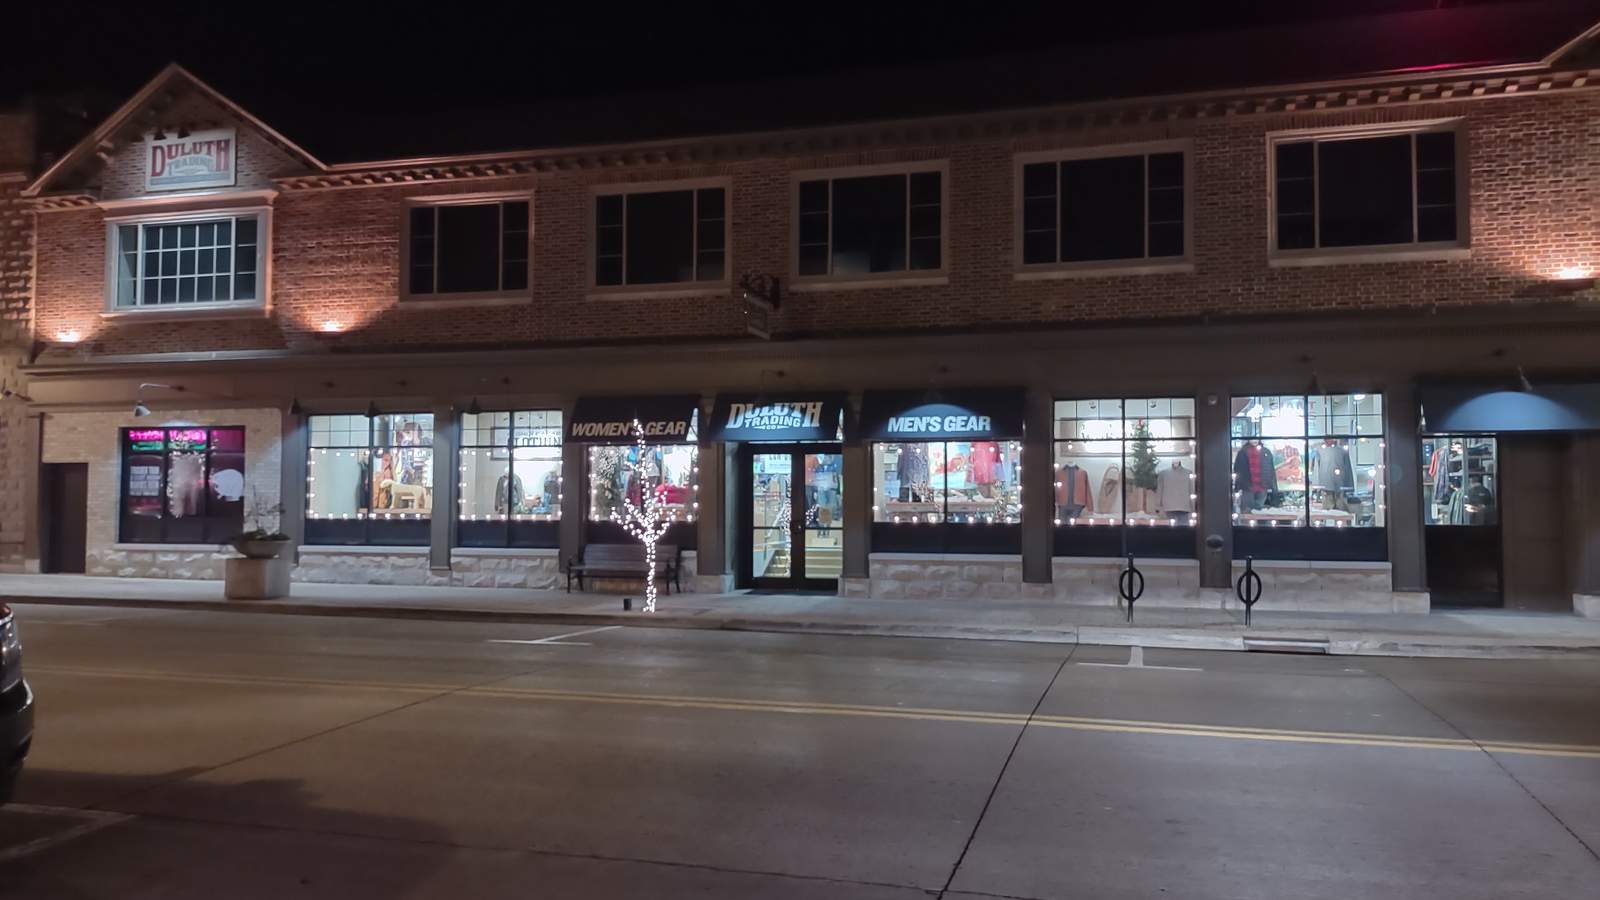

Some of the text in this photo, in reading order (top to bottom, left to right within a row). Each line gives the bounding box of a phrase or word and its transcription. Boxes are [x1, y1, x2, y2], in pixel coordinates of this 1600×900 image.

[151, 139, 230, 177] DULUTH
[725, 402, 823, 429] DULUTH
[744, 415, 801, 428] TRADING
[887, 415, 992, 433] MEN'S GEAR
[644, 420, 687, 436] GEAR
